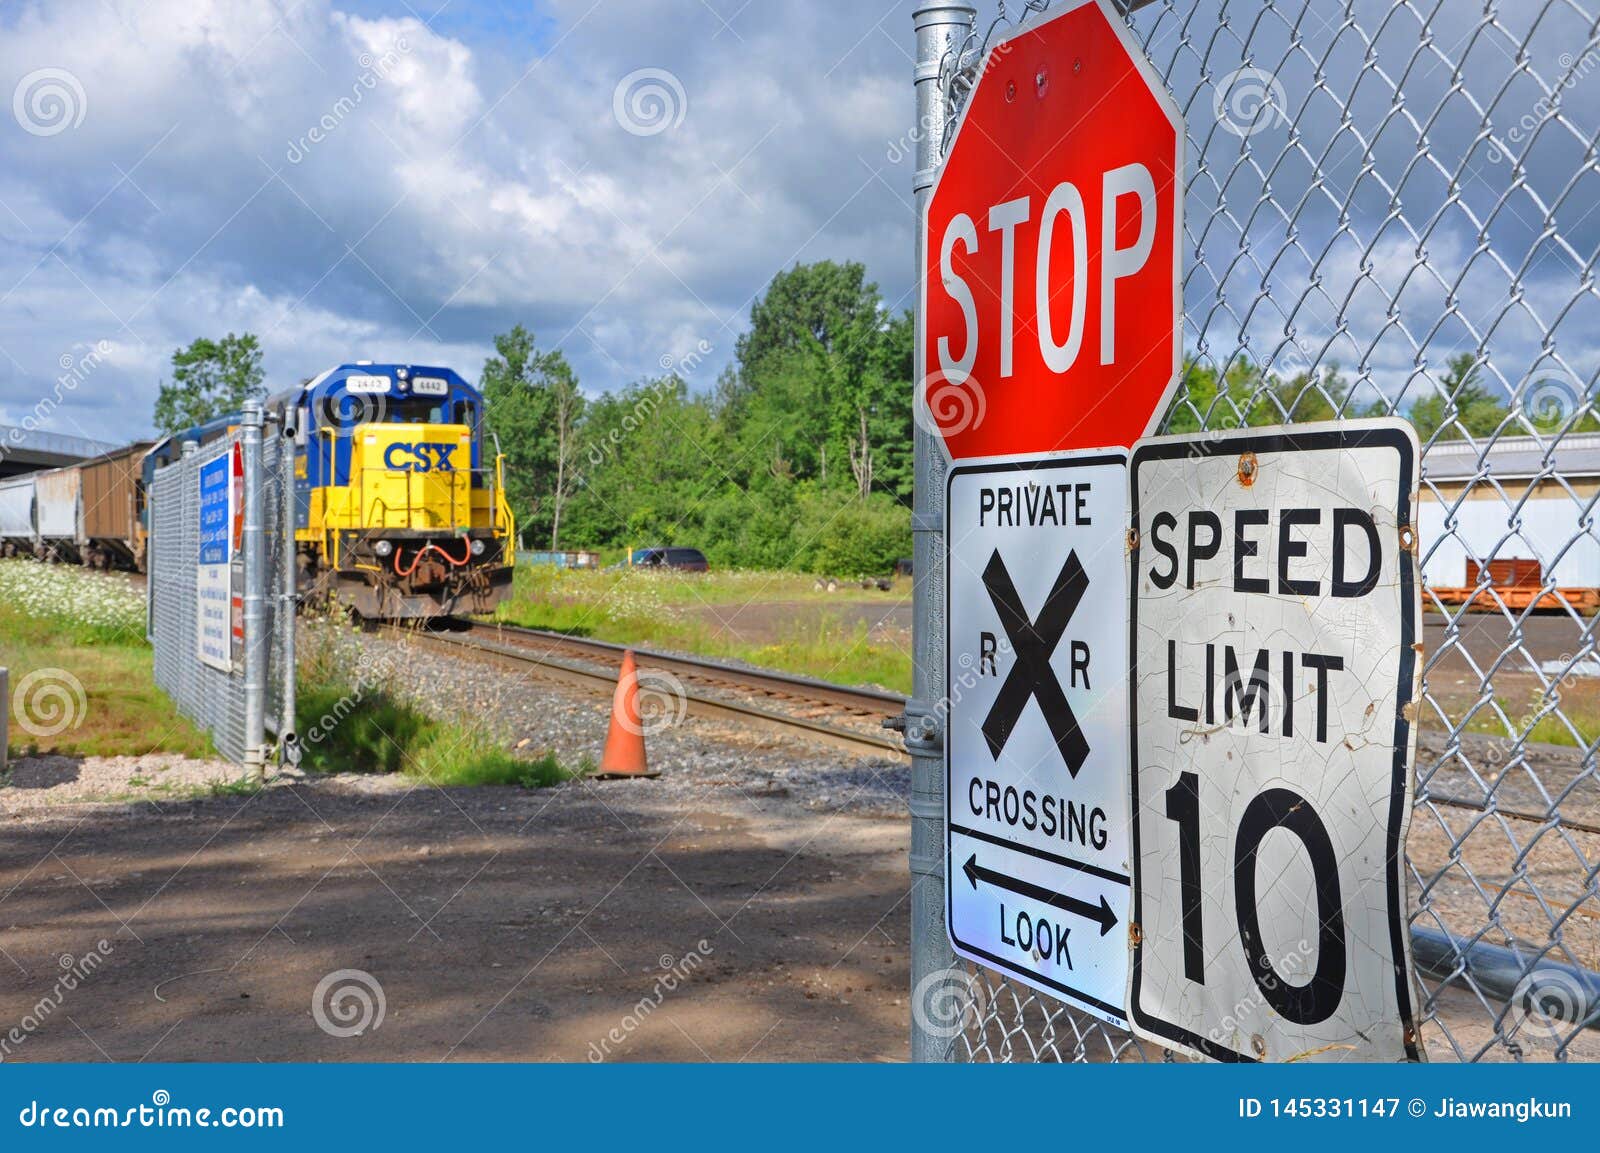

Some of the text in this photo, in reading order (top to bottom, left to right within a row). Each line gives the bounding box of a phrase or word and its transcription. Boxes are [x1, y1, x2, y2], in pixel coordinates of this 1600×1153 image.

[937, 162, 1157, 386] STOP
[383, 442, 458, 473] CSX
[980, 483, 1092, 527] PRIVATE
[1149, 508, 1382, 598] SPEED
[980, 631, 997, 677] R
[1070, 640, 1091, 690] R
[1168, 639, 1344, 744] LIMIT
[968, 776, 1108, 851] CROSSING
[1165, 770, 1347, 1026] 10
[1000, 903, 1074, 971] LOOK
